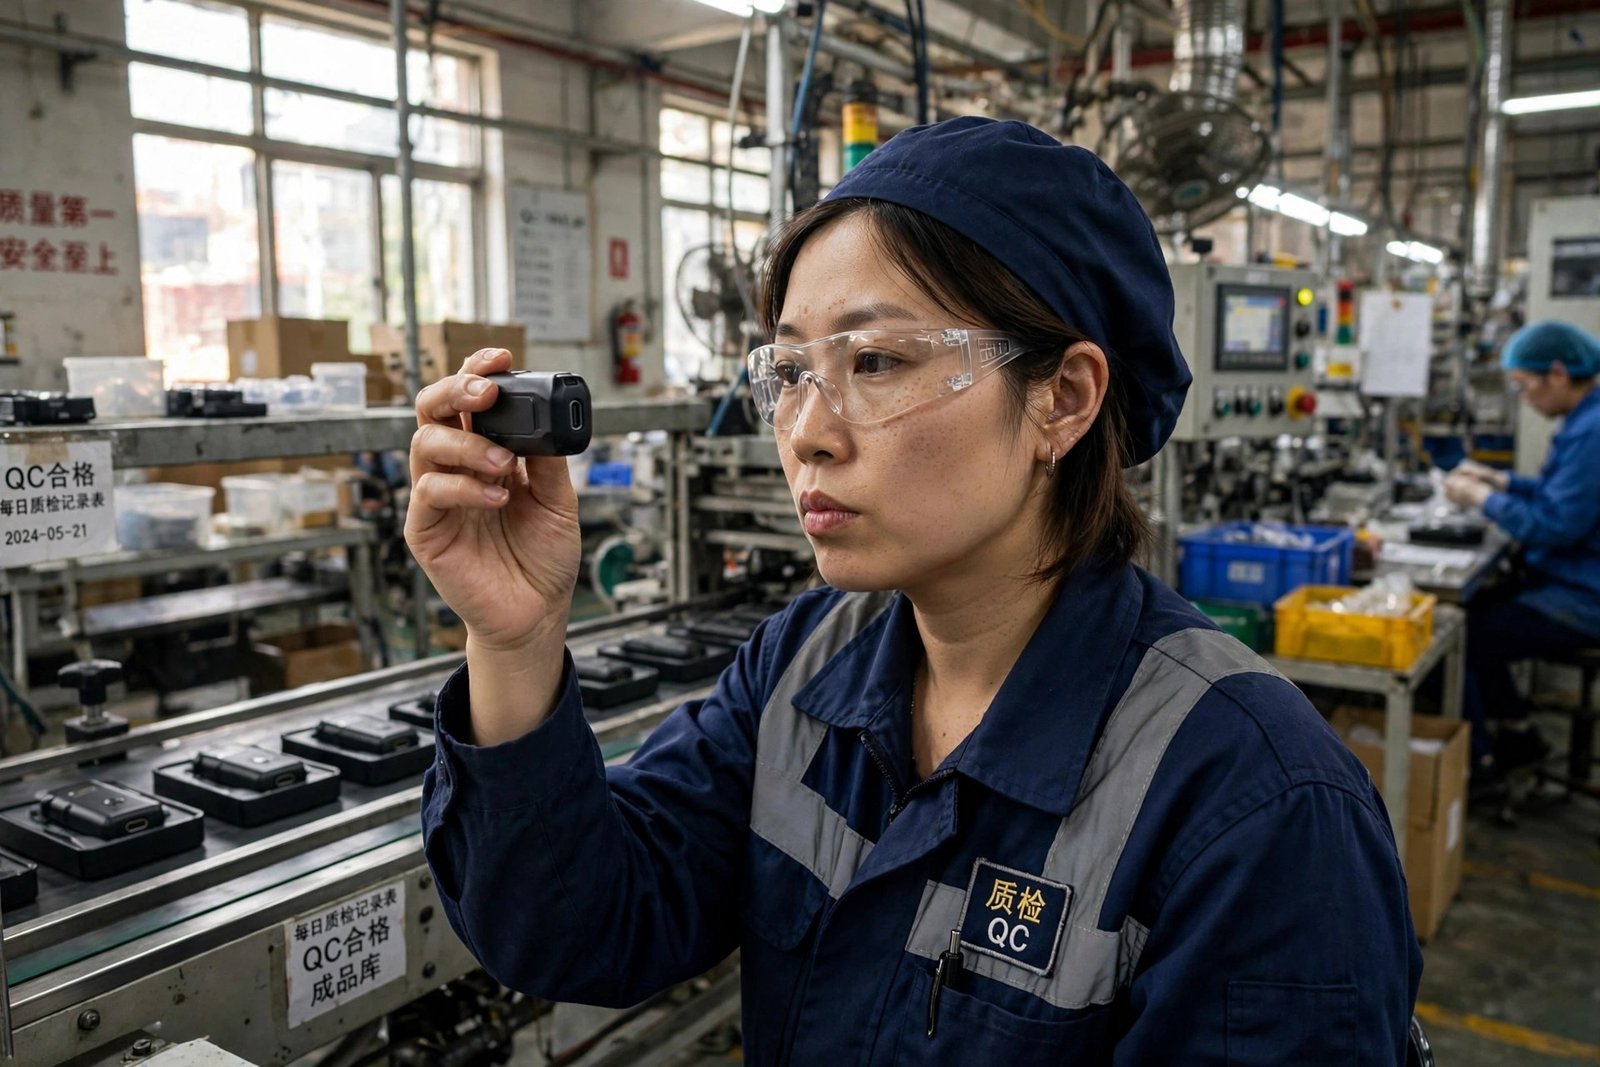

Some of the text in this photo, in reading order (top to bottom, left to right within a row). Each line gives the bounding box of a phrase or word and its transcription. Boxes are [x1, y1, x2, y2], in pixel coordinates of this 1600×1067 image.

[0, 190, 117, 228] 质量第一
[0, 236, 119, 276] 安全至上
[5, 461, 95, 490] QC合格
[0, 492, 104, 516] 每日质检记录表
[5, 523, 87, 545] 2024-05-21
[294, 888, 397, 942] 每日质检记录表
[985, 878, 1046, 924] 质检
[303, 915, 390, 972] QC合格
[987, 917, 1030, 952] QC
[311, 952, 381, 1007] 成品库
